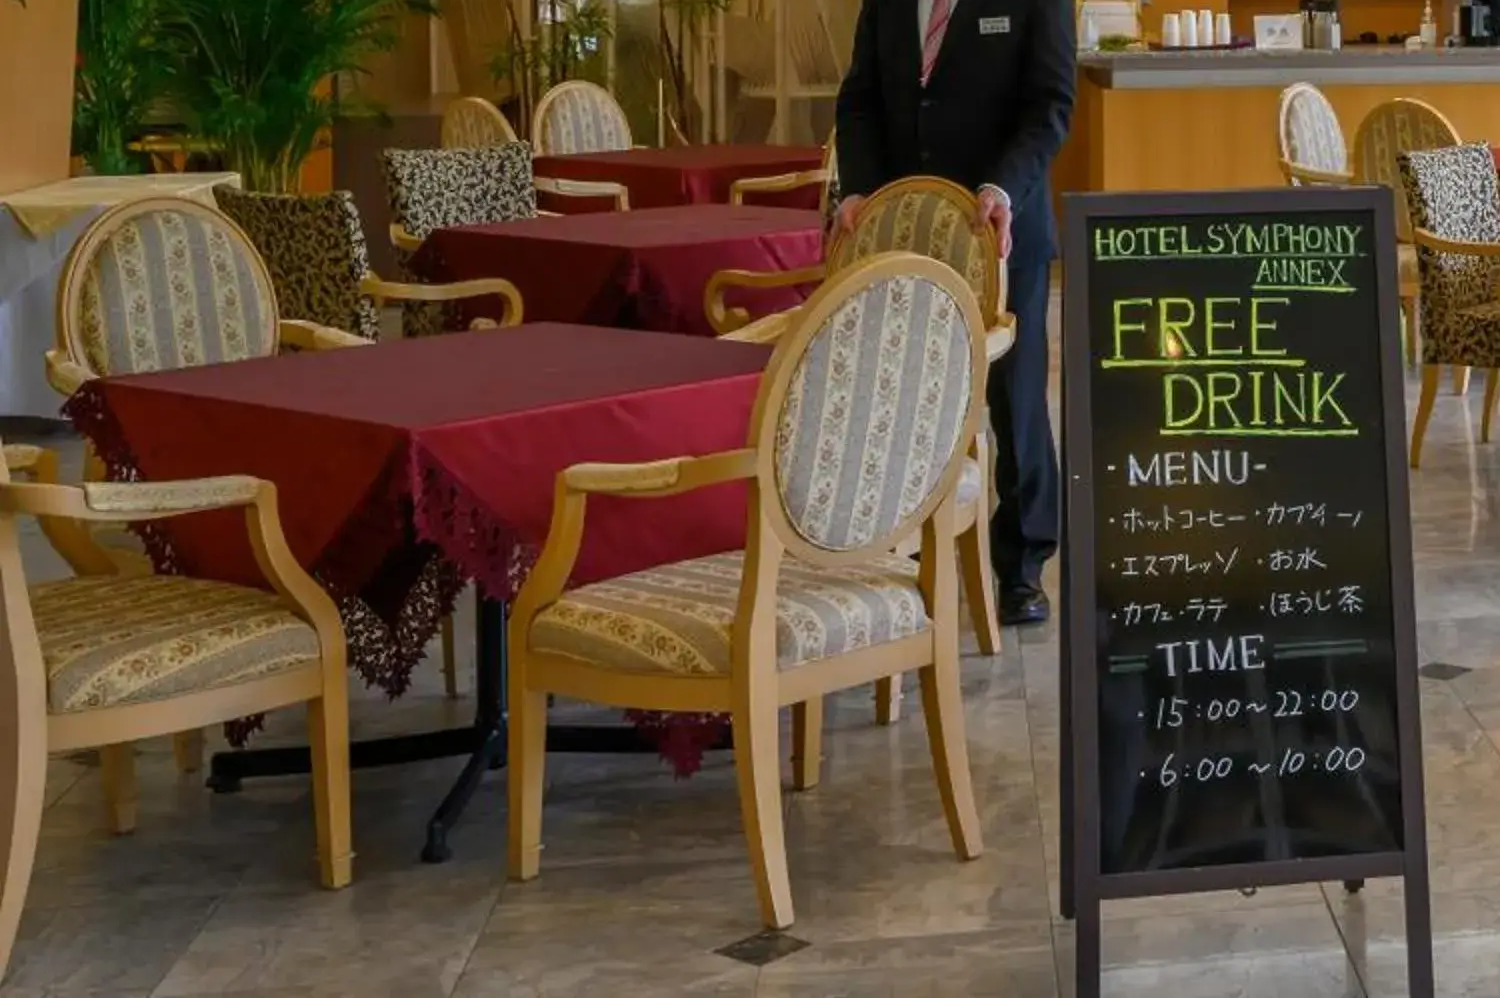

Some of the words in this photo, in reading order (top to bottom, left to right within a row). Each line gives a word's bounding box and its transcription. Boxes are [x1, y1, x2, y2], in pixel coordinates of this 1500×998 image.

[1095, 225, 1202, 256] HOTEL
[1207, 223, 1363, 256] SYMPHONY
[1255, 259, 1349, 286] ANNEX
[1113, 297, 1291, 360] FREE
[1163, 371, 1353, 429] DRINK
[1269, 546, 1328, 572] お水
[1155, 634, 1266, 677] TIME
